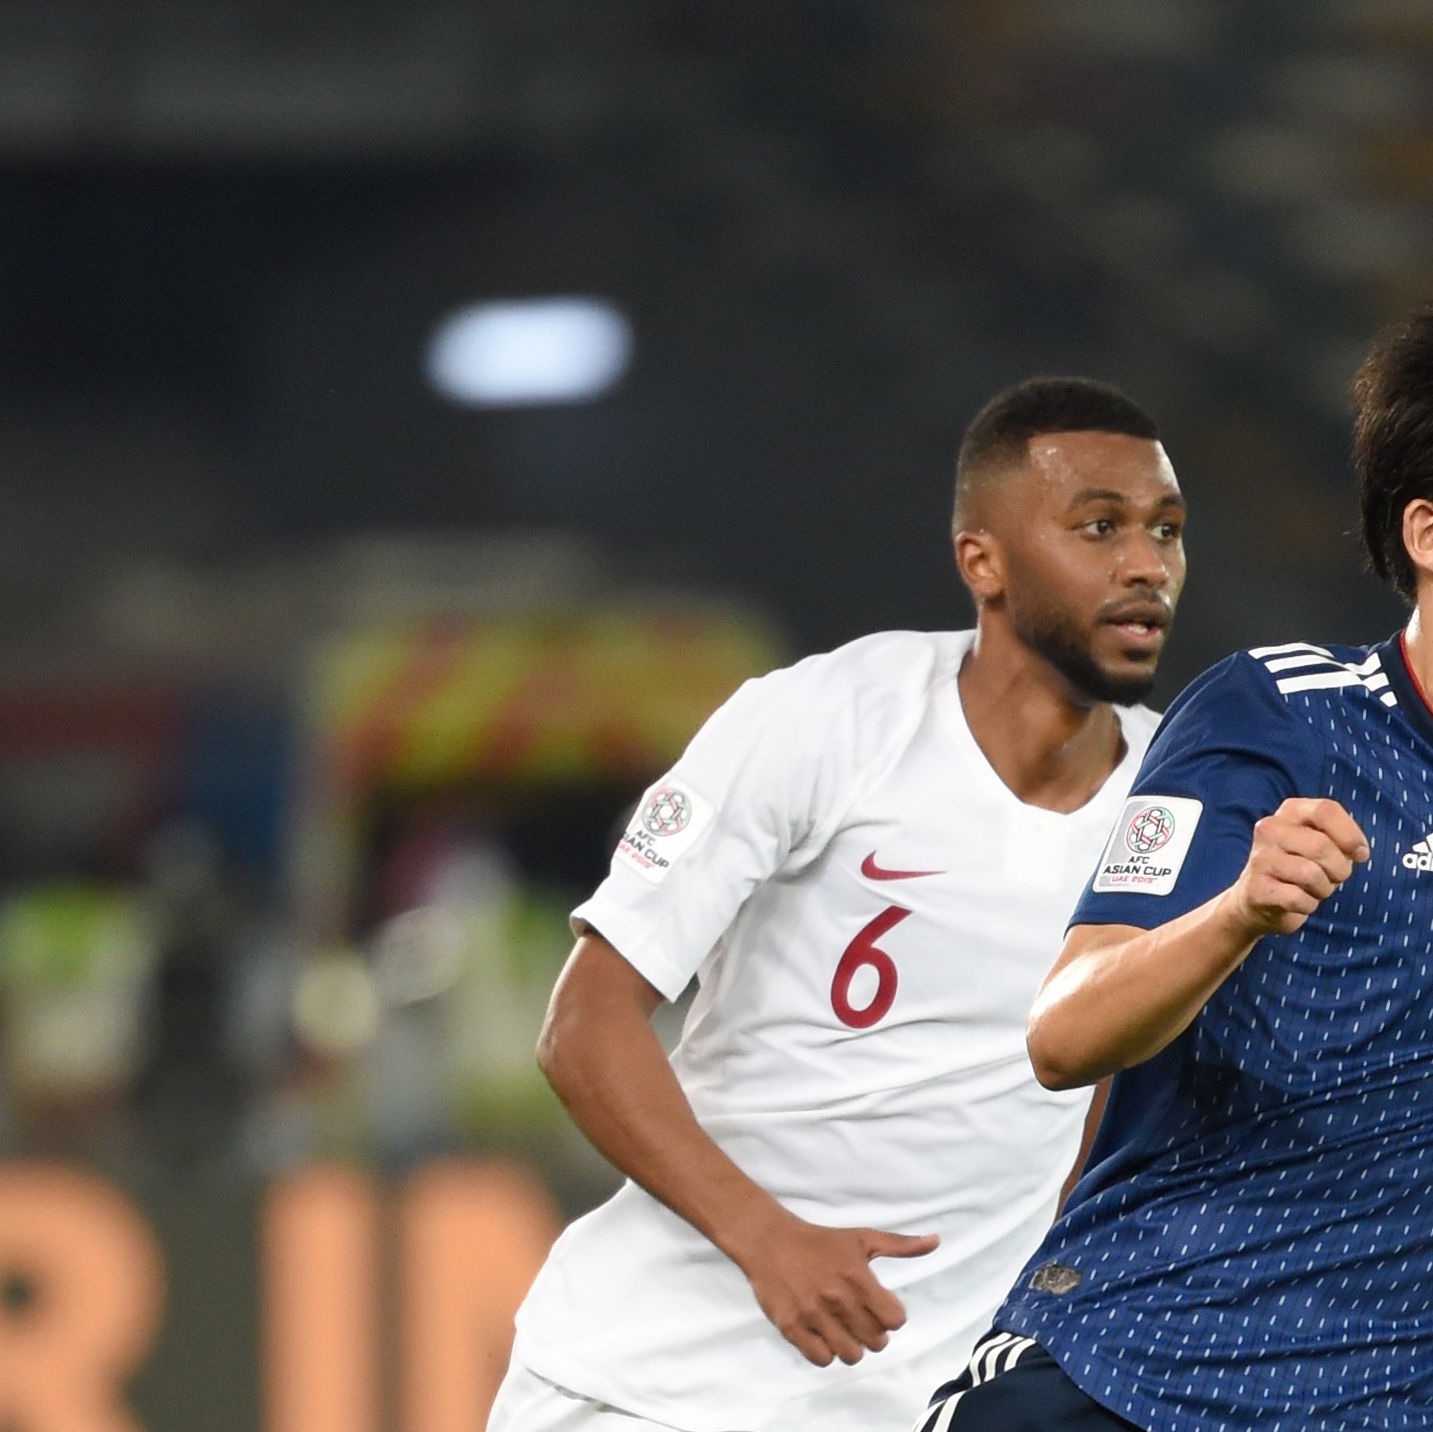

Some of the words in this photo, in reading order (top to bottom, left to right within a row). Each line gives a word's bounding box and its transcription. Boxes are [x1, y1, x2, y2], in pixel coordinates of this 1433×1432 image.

[644, 849, 669, 868] CUP
[1128, 856, 1150, 865] AFC
[1103, 865, 1141, 875] ASIAN
[1143, 866, 1172, 877] CUP
[831, 905, 913, 1029] 6
